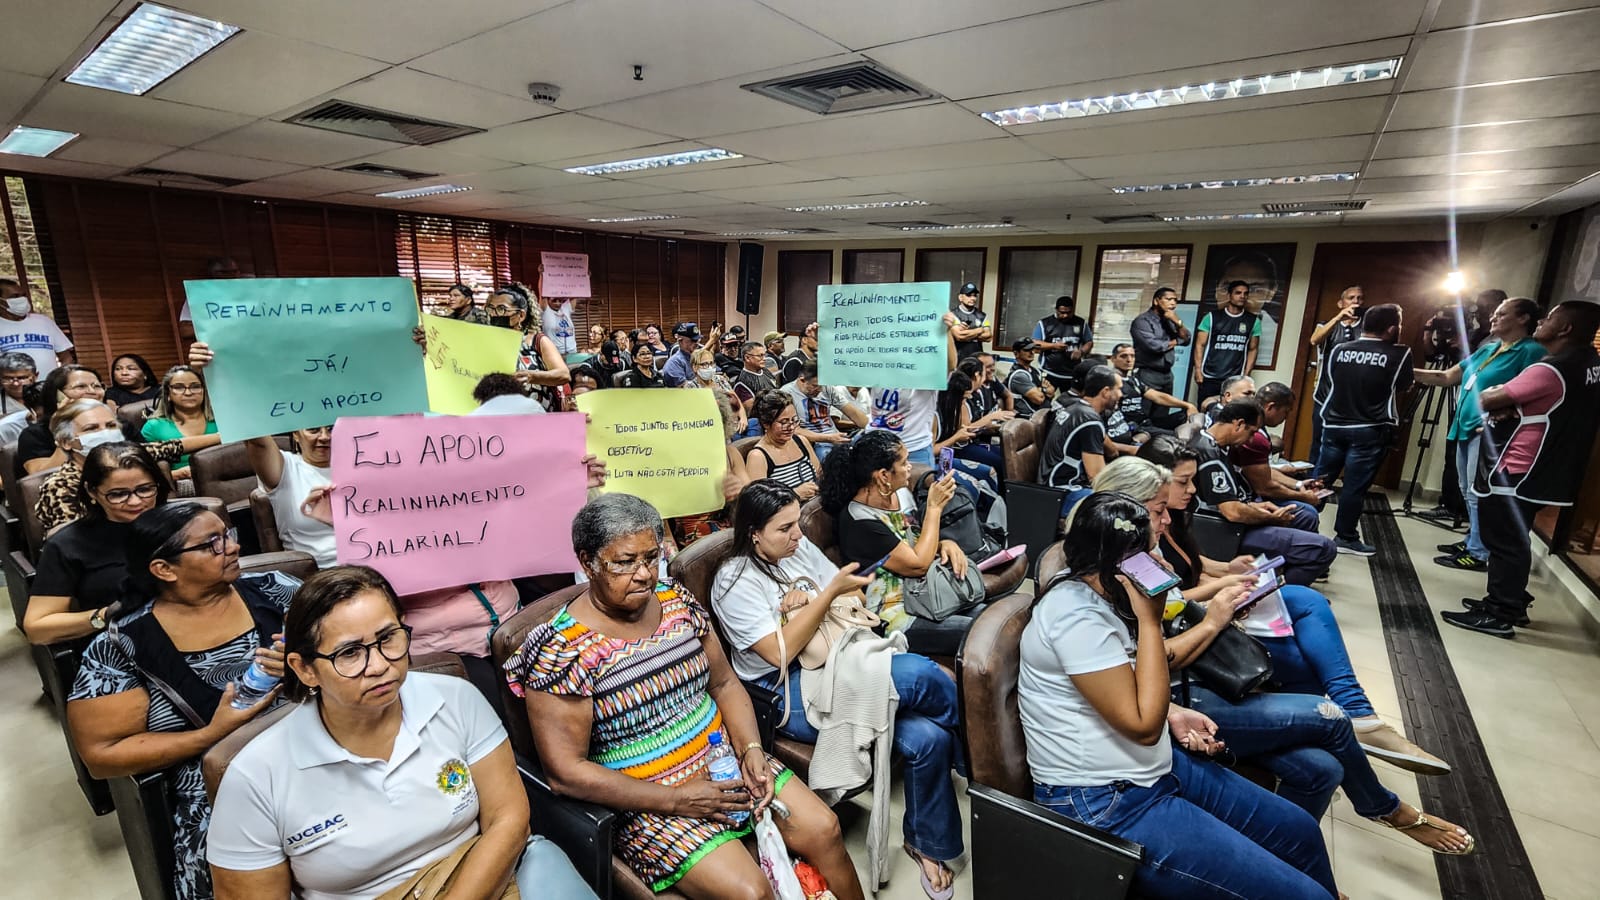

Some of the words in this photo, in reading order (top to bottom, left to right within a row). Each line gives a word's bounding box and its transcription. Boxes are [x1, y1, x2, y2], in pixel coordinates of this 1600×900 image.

[205, 300, 393, 320] REALINHAMENTO
[833, 318, 860, 329] PARA
[865, 315, 894, 325] TODOS
[0, 334, 20, 345] SEST
[24, 333, 50, 343] SENAT
[427, 325, 441, 346] NA
[889, 330, 930, 339] ESTADUAIS
[430, 342, 450, 370] LUTA
[845, 346, 864, 354] APOIO
[902, 346, 913, 354] AS
[303, 353, 349, 373] JÁ!
[1336, 350, 1388, 368] ASPOPEQ
[270, 401, 304, 417] EU
[614, 423, 638, 434] TODOS
[640, 421, 669, 432] JUNTOS
[420, 432, 505, 465] APOIO
[607, 444, 653, 457] OBJETIVO
[614, 468, 634, 479] LUTA
[637, 466, 655, 478] NÃO
[656, 466, 676, 478] ESTÁ
[677, 465, 709, 477] PERDIDA
[286, 813, 345, 846] JUCEAC
